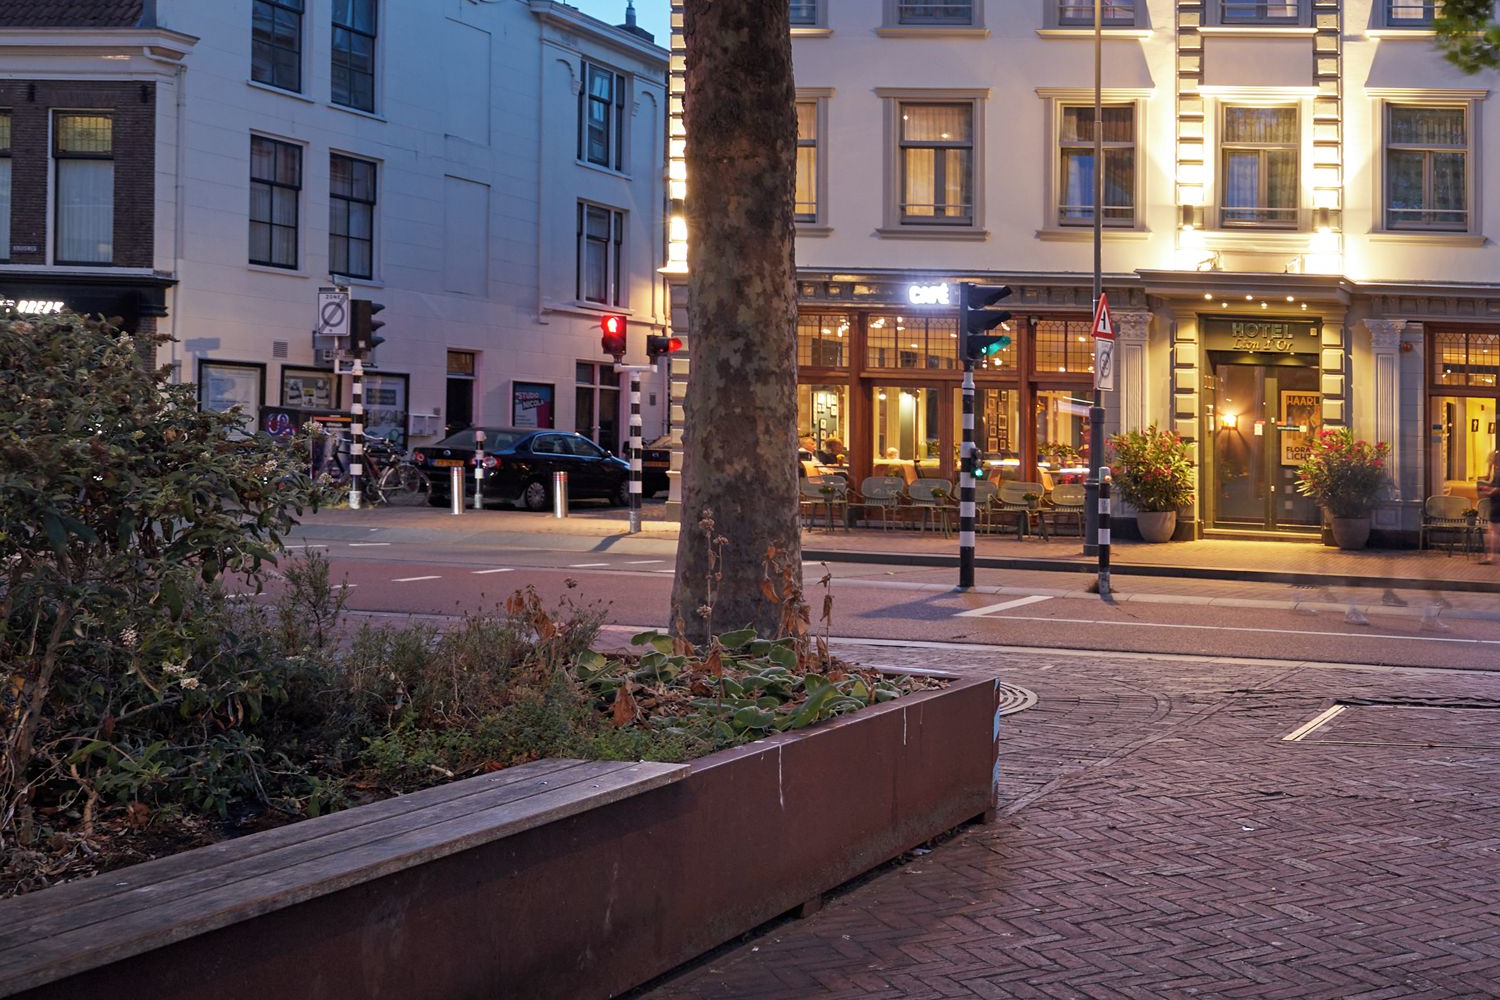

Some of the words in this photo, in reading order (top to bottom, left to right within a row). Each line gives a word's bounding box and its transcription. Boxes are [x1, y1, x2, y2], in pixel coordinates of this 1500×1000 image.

[16, 299, 65, 315] BREAK
[1231, 322, 1294, 339] HOTEL
[518, 391, 540, 400] STUDIO
[522, 399, 545, 409] NICOLA
